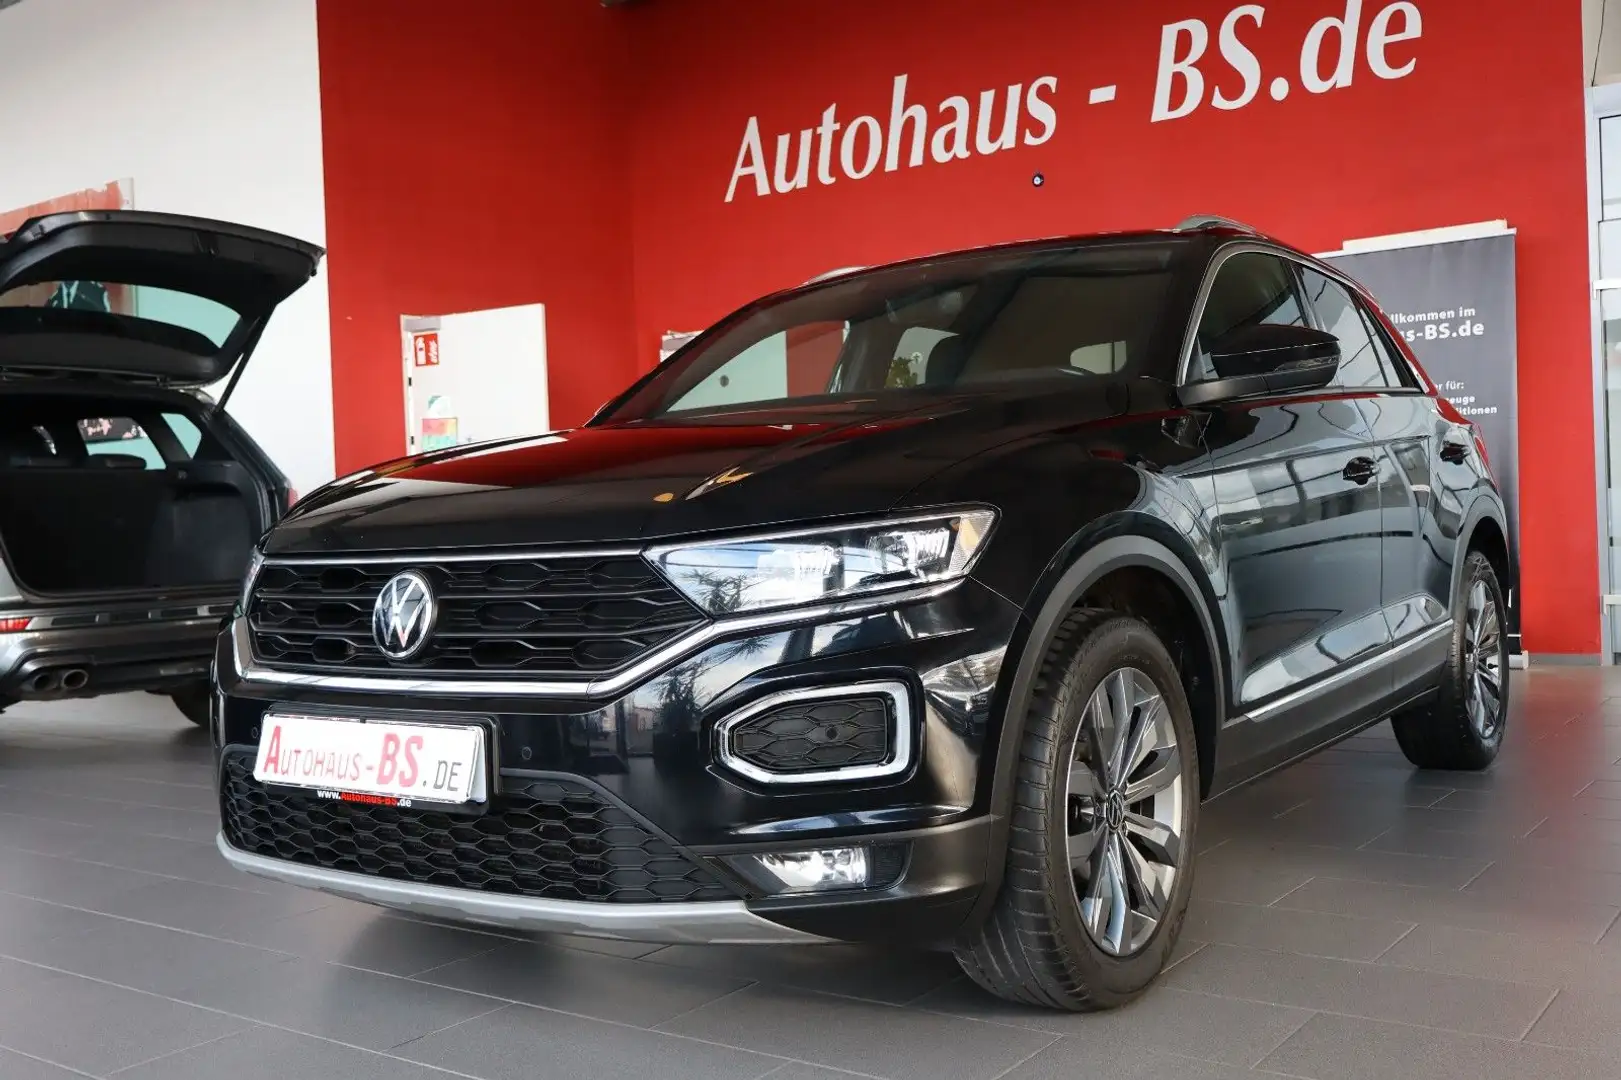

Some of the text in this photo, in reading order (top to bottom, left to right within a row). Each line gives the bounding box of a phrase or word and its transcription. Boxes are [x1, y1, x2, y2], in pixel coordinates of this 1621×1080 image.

[724, 0, 1423, 203] Autohaus - BS.de
[1389, 307, 1476, 324] llkommen im
[1456, 406, 1498, 415] itionen
